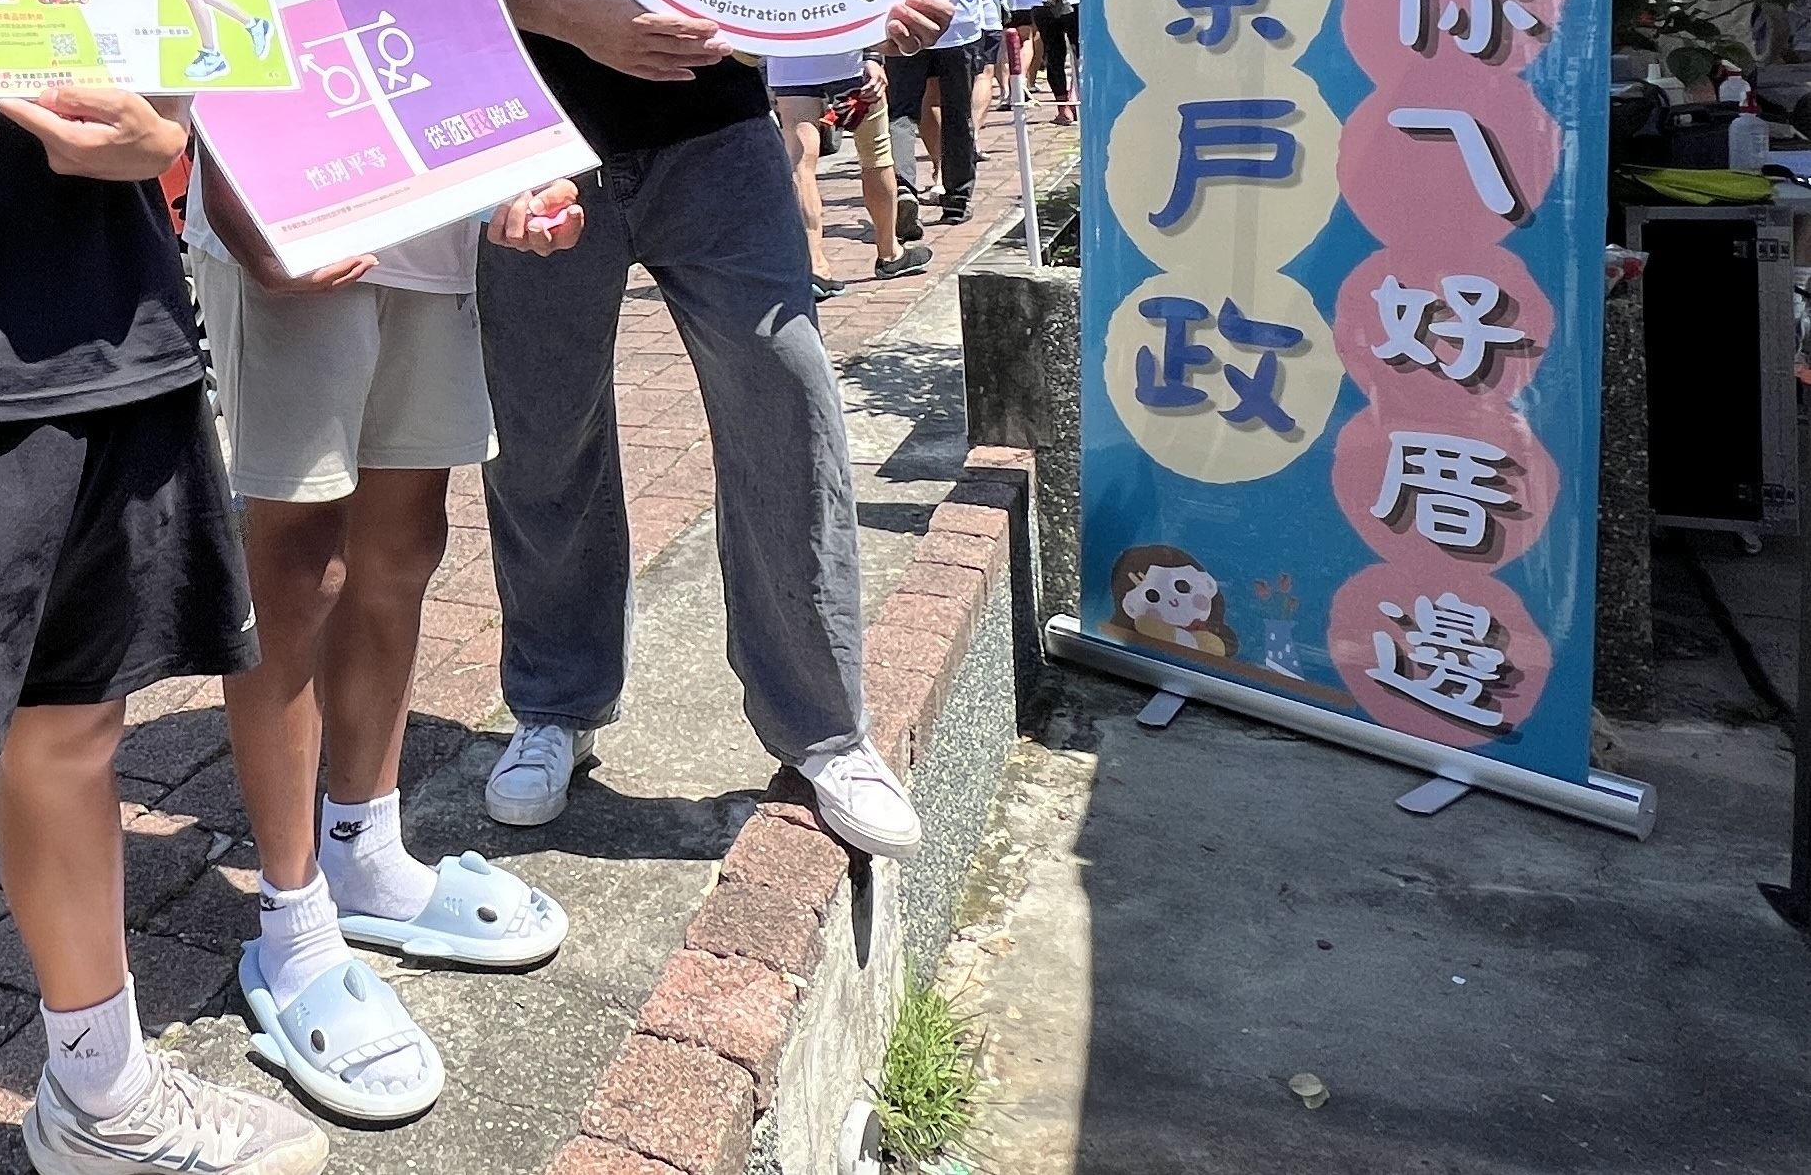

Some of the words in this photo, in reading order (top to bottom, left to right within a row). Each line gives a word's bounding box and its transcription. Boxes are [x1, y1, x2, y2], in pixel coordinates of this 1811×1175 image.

[801, 1, 847, 21] Office
[303, 145, 388, 192] 性別平等
